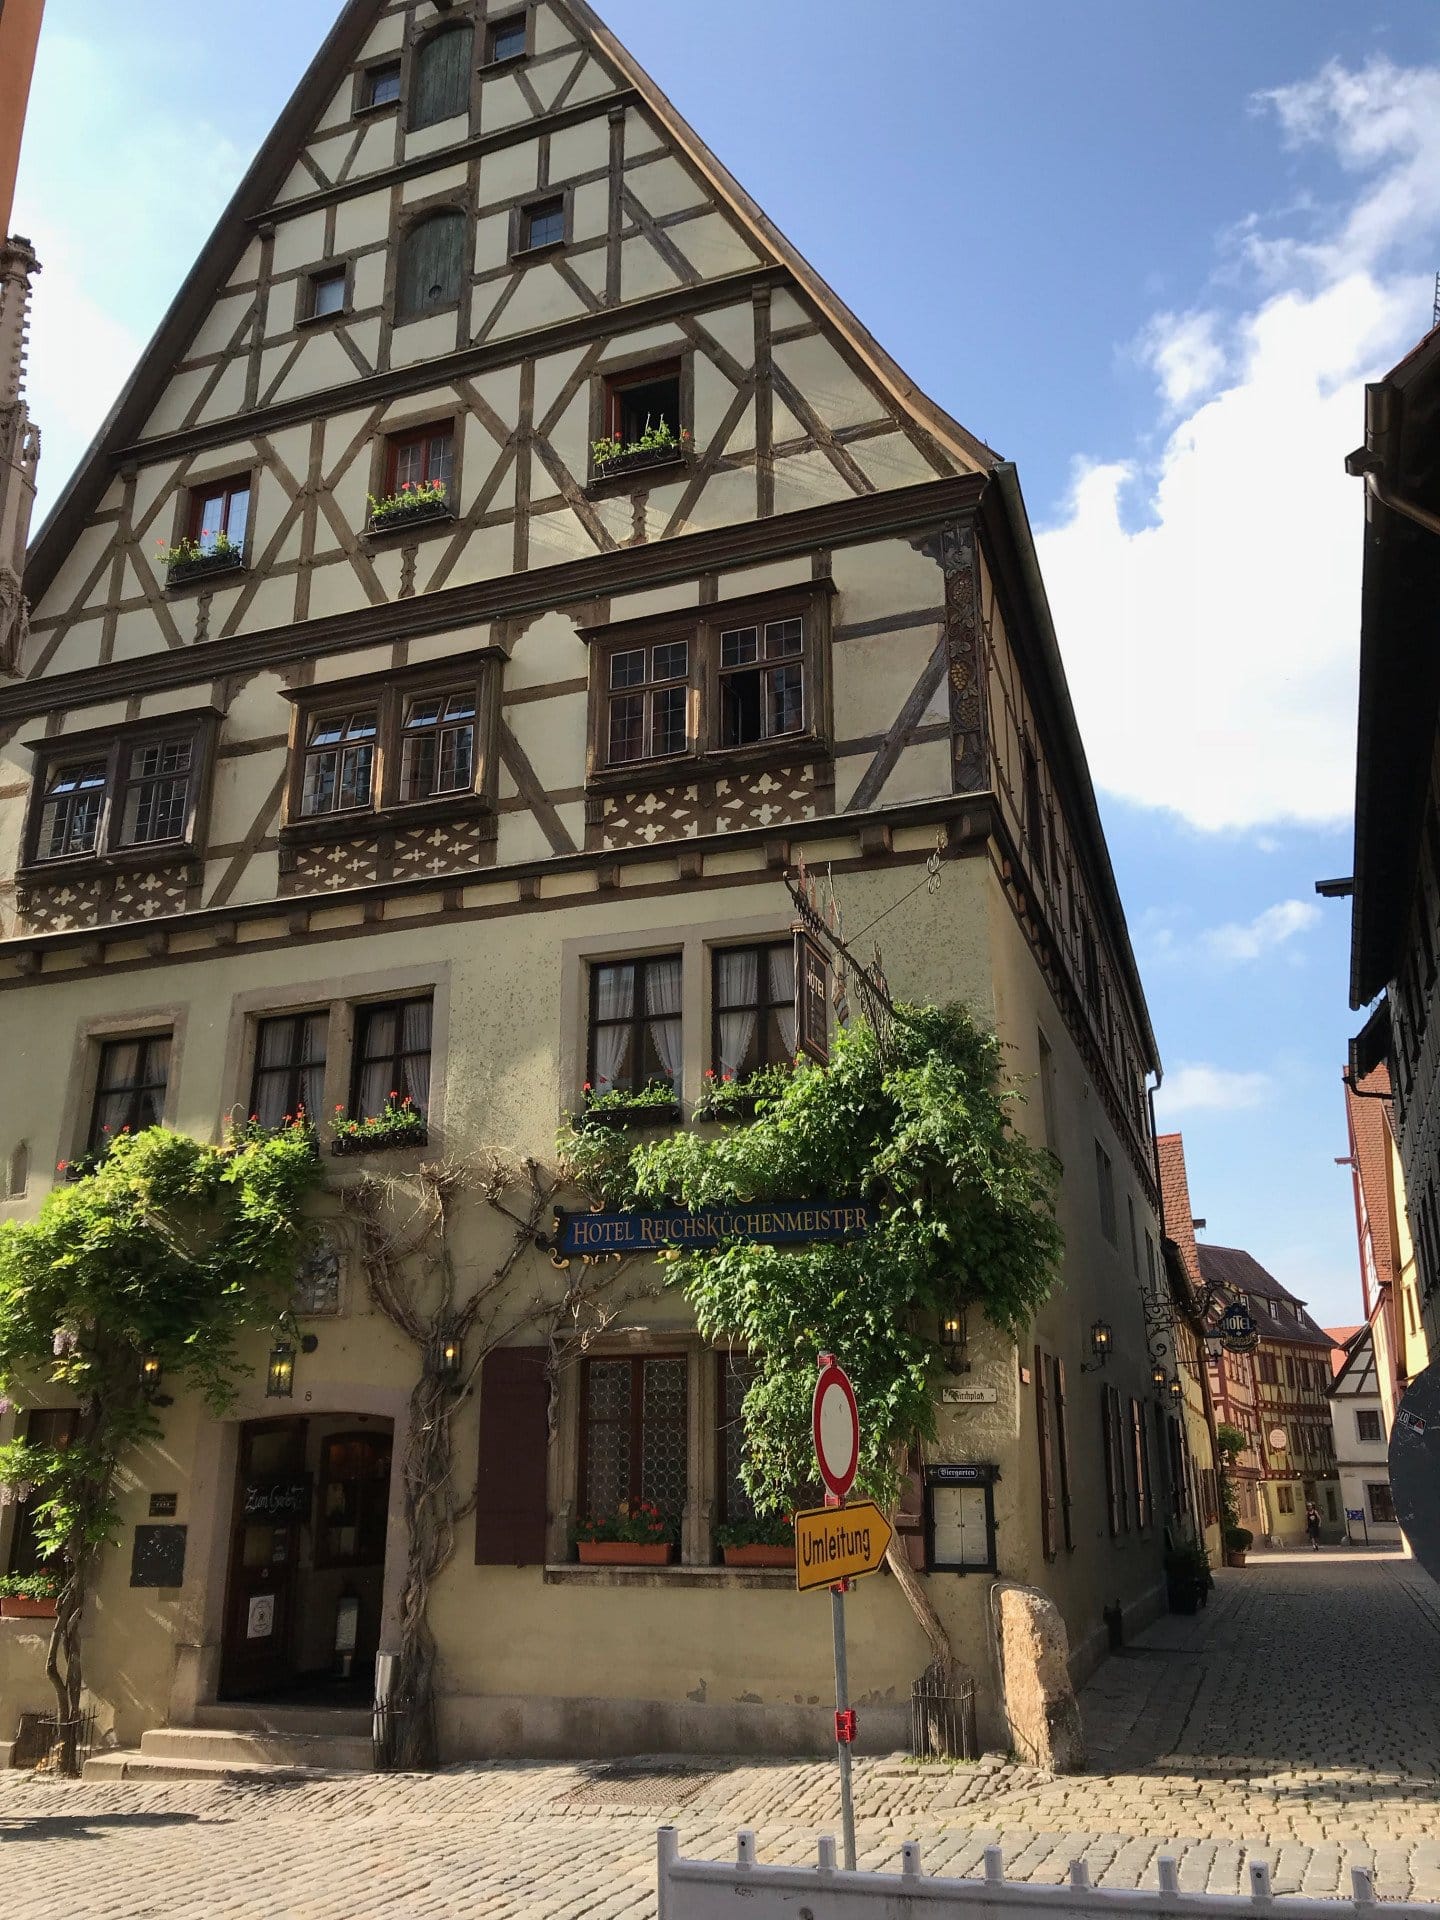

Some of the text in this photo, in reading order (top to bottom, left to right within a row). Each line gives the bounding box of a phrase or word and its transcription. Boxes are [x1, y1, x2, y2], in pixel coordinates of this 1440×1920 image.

[807, 969, 825, 1001] HOTEL
[573, 1207, 868, 1245] HOTEL REICHSKÜCHENMEISTER
[1221, 1315, 1253, 1330] HOTEL
[304, 1390, 312, 1402] 8
[940, 1467, 975, 1477] Biergarten
[803, 1527, 870, 1567] Umleitung
